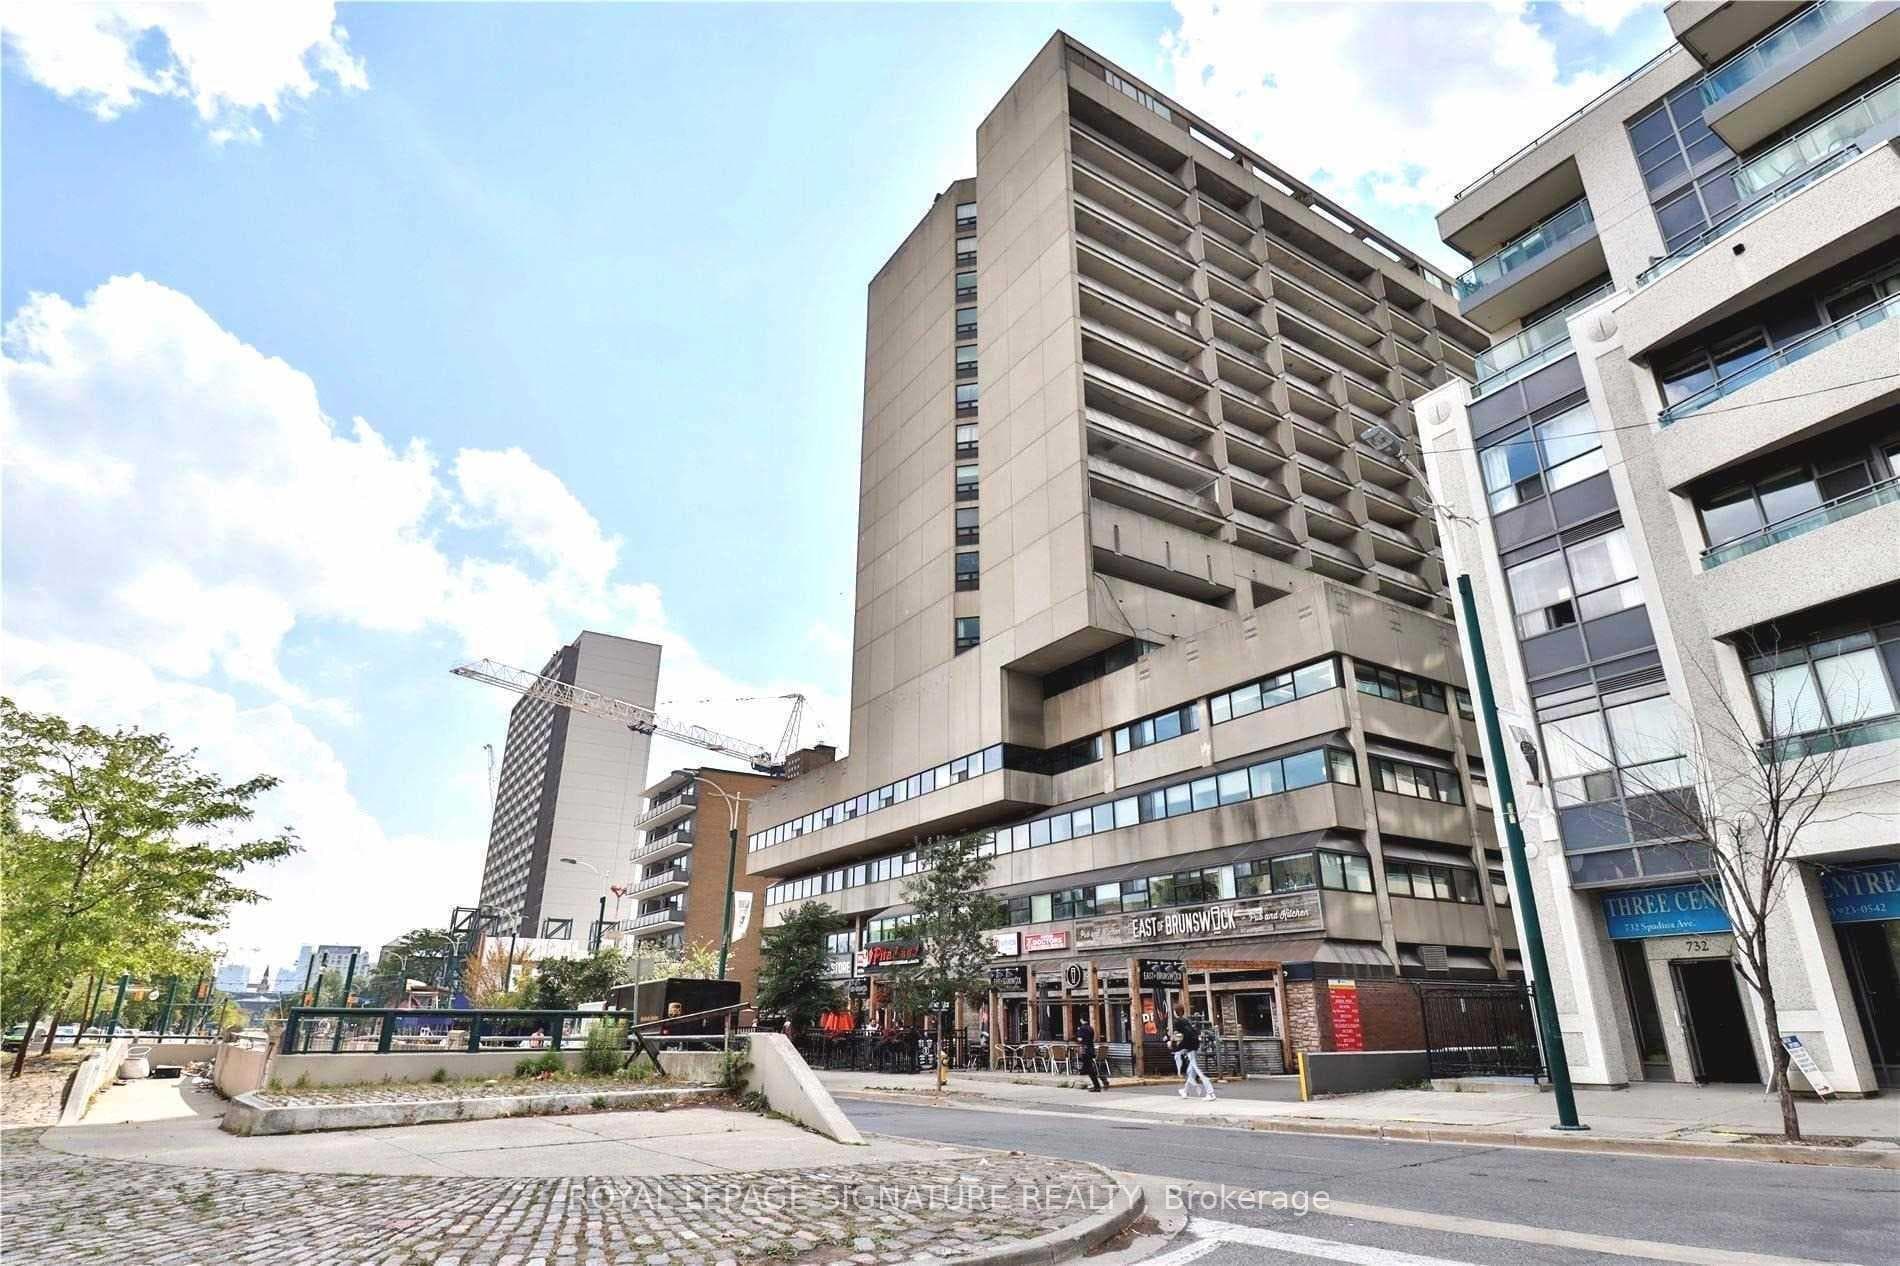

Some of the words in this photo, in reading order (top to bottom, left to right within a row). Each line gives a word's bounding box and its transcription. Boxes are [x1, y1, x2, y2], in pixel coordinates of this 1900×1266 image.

[1607, 891, 1671, 917] THREE
[1132, 916, 1157, 938] EAST
[1641, 920, 1676, 932] Spadina
[1686, 940, 1710, 952] 732
[830, 960, 851, 975] STORE
